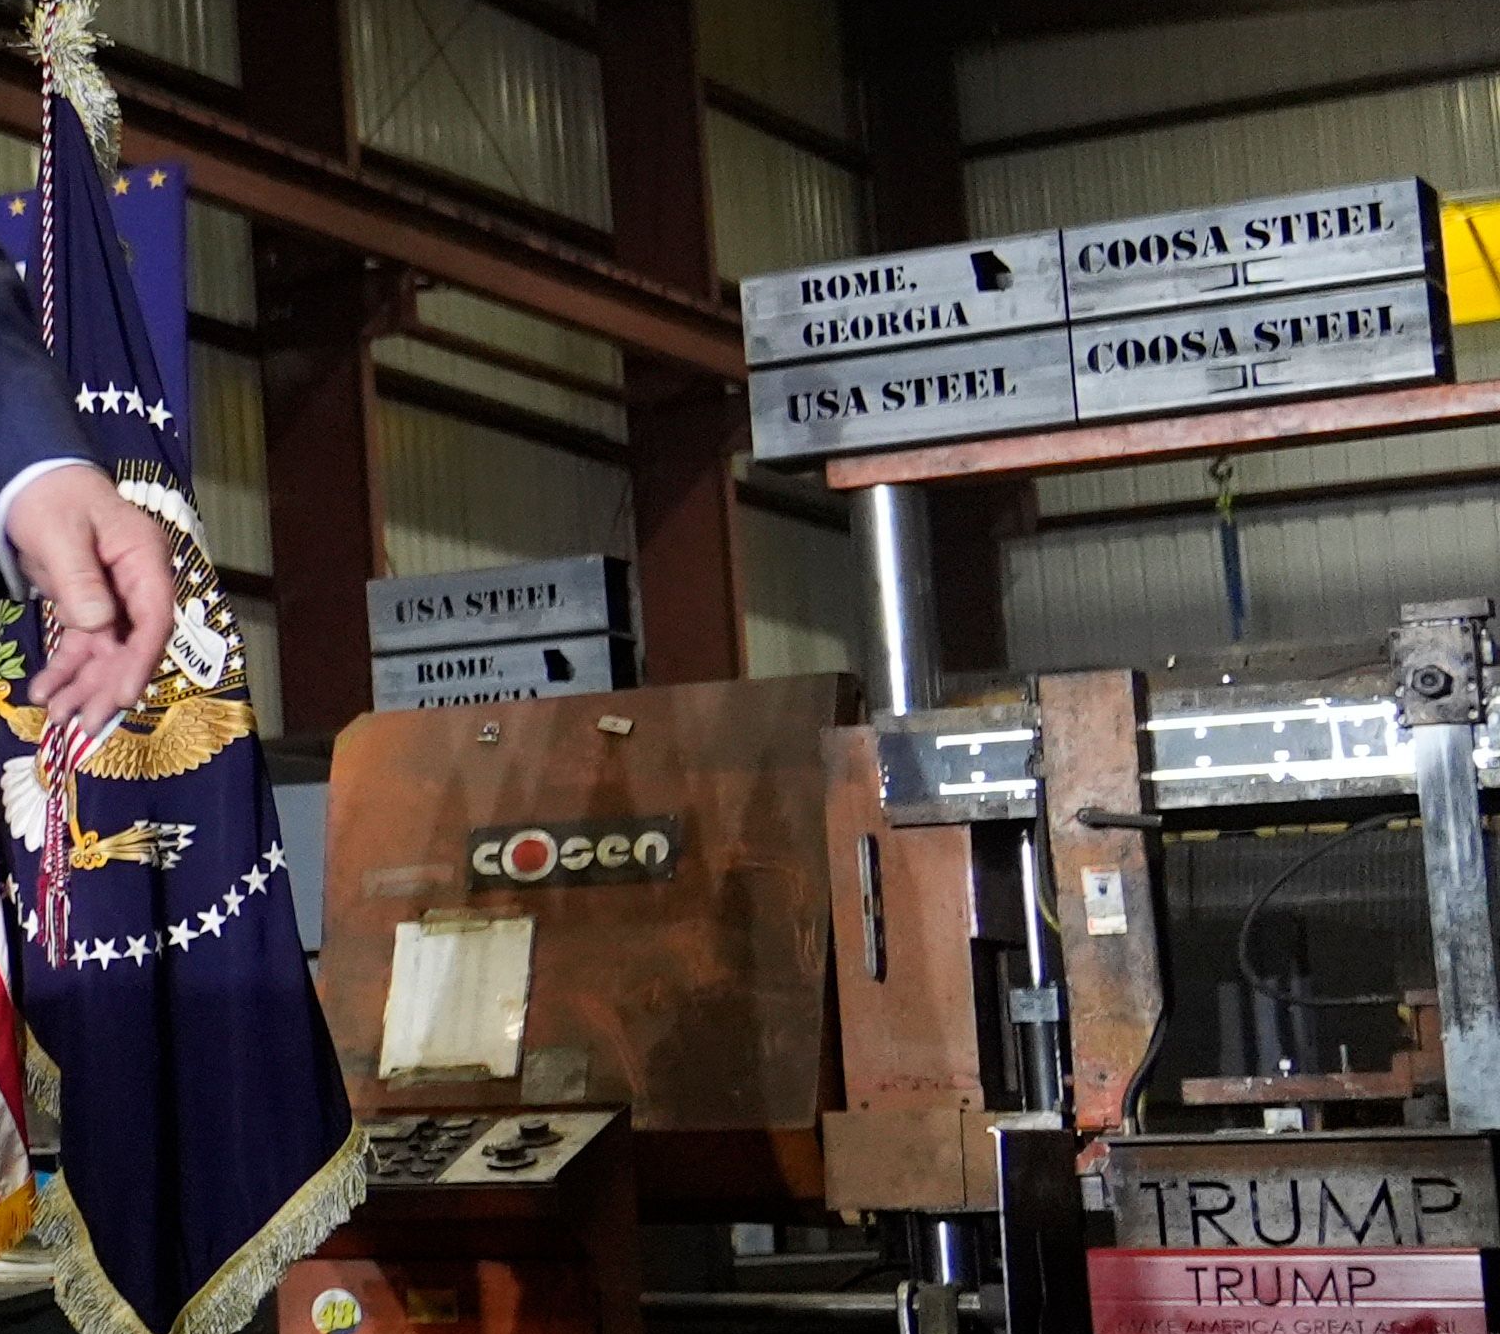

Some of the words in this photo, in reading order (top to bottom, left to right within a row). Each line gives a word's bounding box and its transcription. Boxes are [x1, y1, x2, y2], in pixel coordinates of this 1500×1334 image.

[1077, 224, 1231, 275] COOSA
[1243, 201, 1396, 251] STEEL
[800, 265, 918, 305] ROME,
[802, 300, 969, 349] GEORGIA
[1086, 325, 1240, 376] COOSA
[1253, 304, 1407, 354] STEEL
[786, 387, 871, 425] USA
[881, 367, 1018, 413] STEEL
[395, 595, 455, 624] USA
[464, 582, 565, 616] STEEL
[173, 634, 213, 678] UNUM
[1140, 1177, 1461, 1247] TRUMP
[1185, 1266, 1377, 1307] TRUMP
